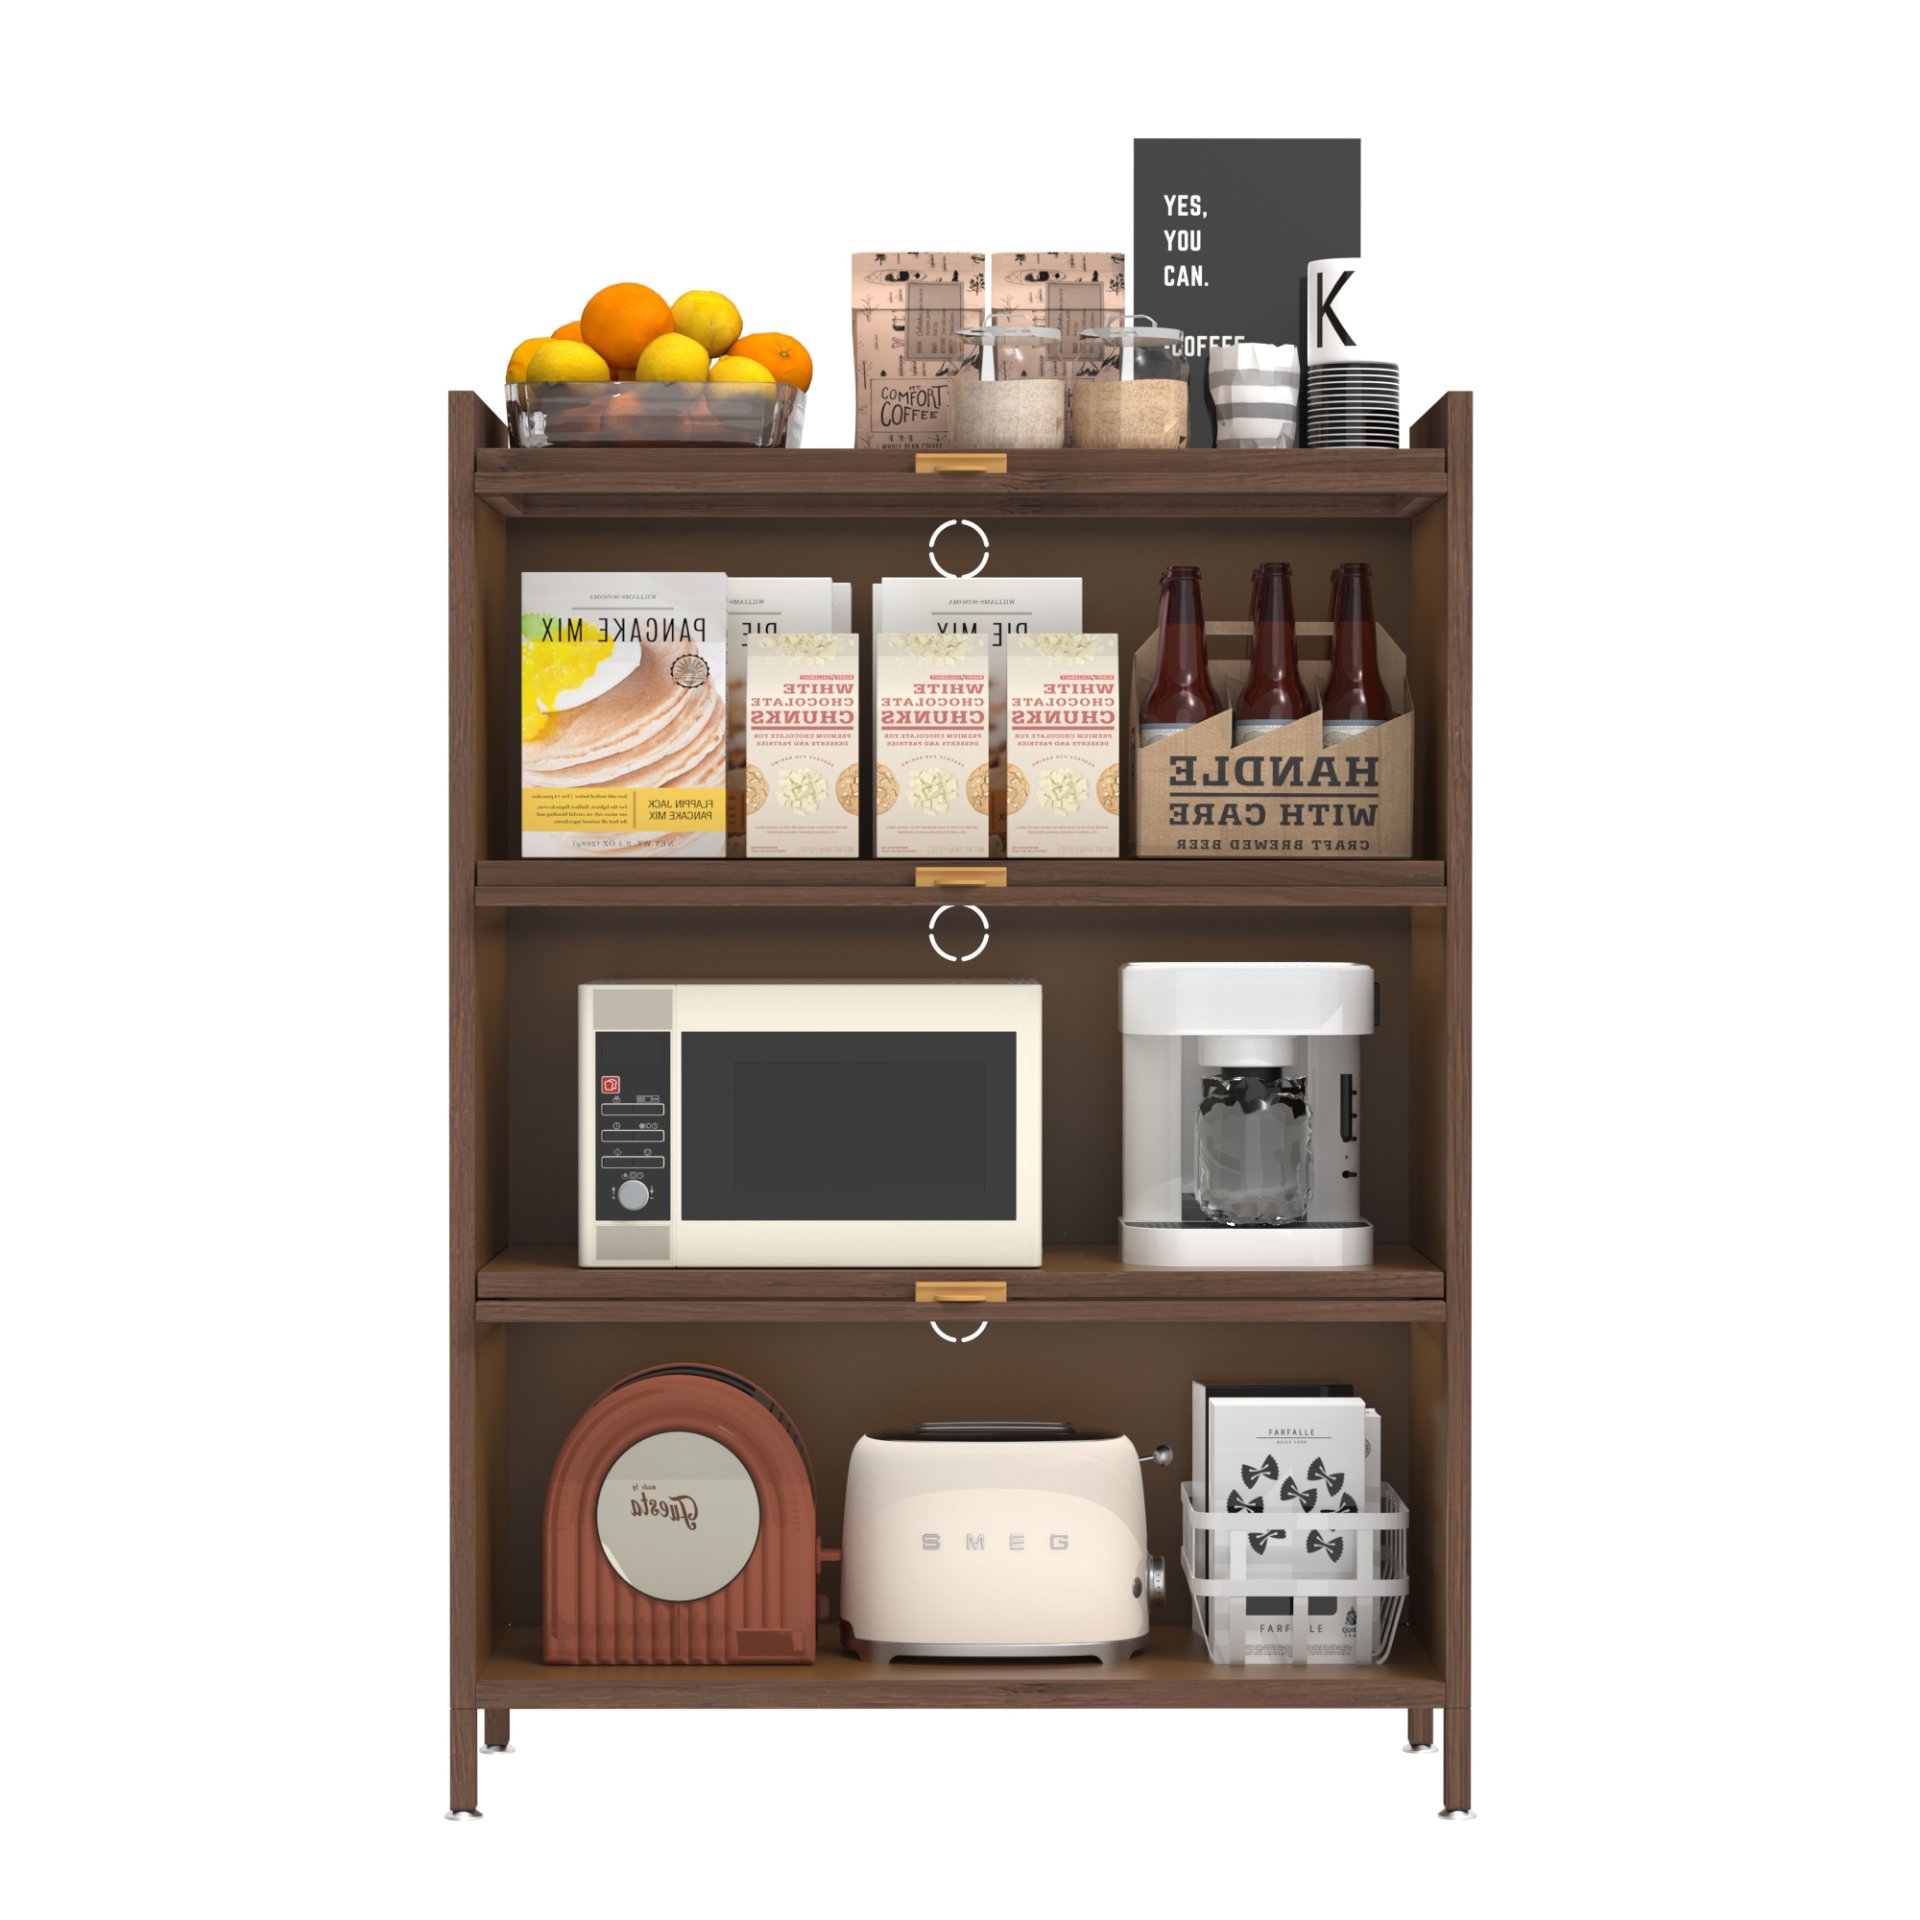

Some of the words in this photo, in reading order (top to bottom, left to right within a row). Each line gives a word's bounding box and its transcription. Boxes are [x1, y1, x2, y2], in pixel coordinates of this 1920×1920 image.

[1163, 194, 1208, 219] YES,
[1163, 229, 1201, 251] YOU
[1163, 264, 1209, 287] CAN.
[1316, 270, 1357, 348] K
[880, 385, 949, 409] COMFORT
[880, 401, 939, 427] COFFEE
[1268, 1428, 1316, 1436] FARFALLE
[922, 1533, 1069, 1551] SMEG
[1260, 1624, 1323, 1633] FARFLE
